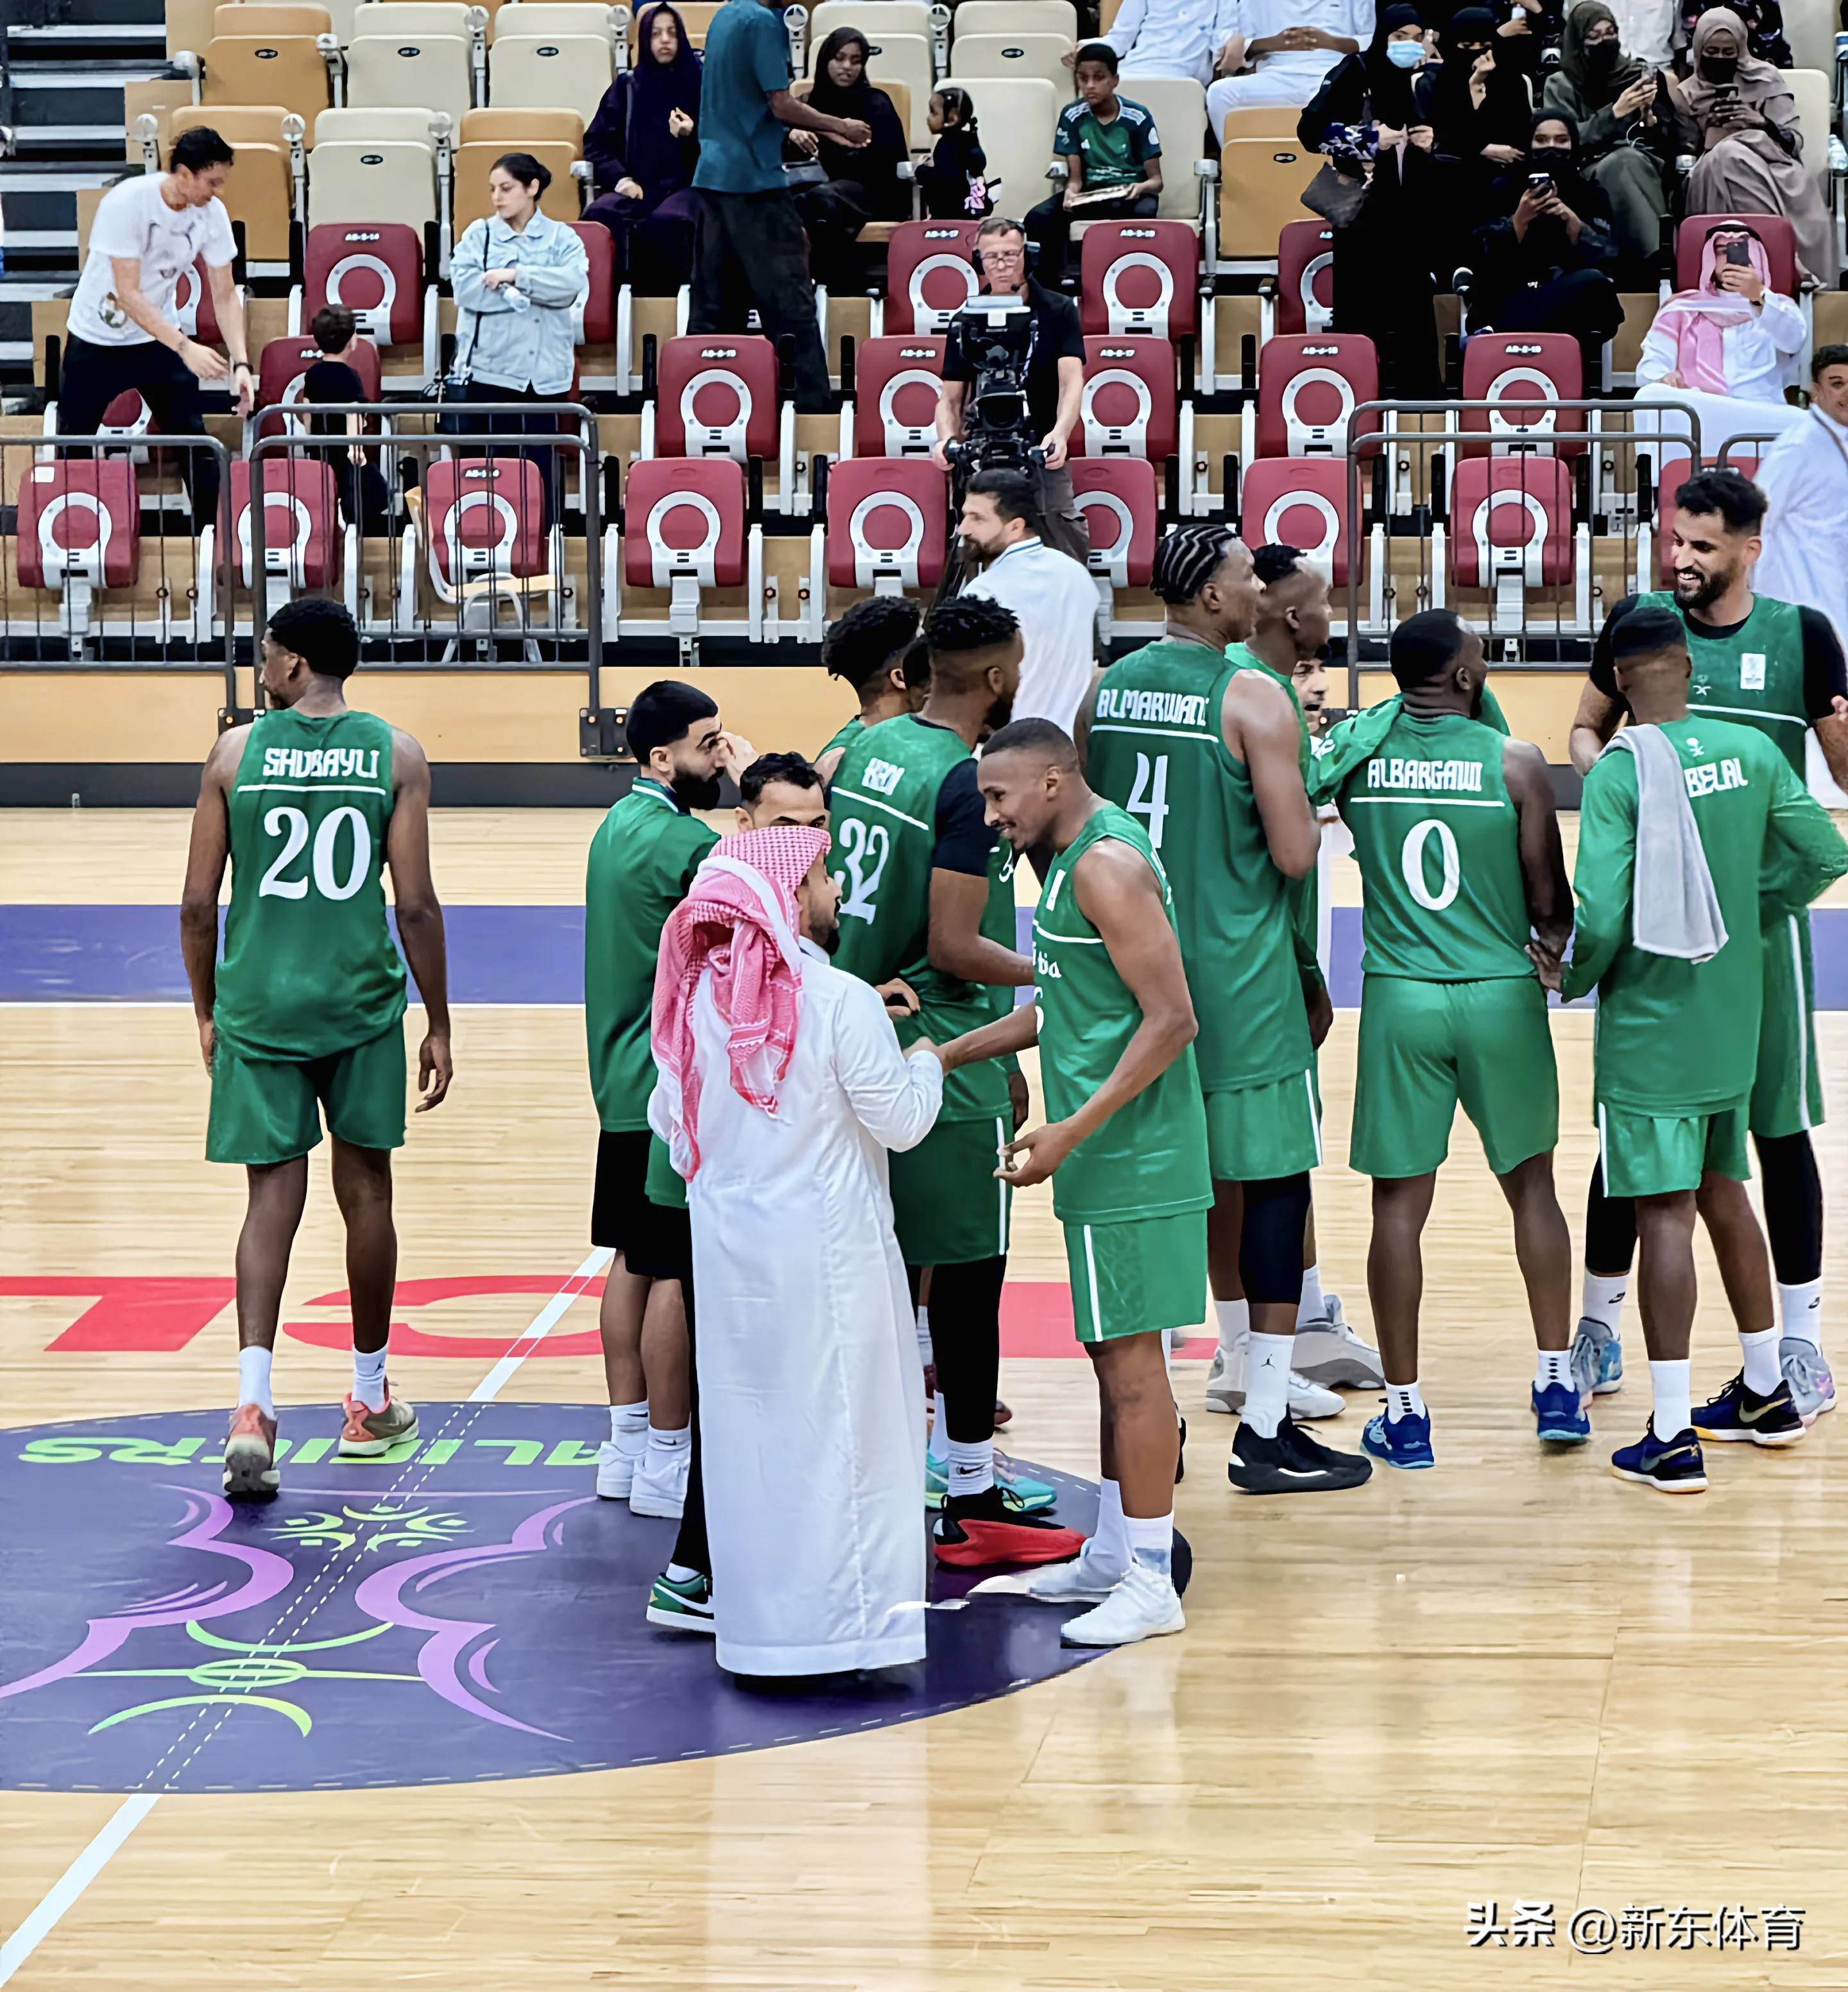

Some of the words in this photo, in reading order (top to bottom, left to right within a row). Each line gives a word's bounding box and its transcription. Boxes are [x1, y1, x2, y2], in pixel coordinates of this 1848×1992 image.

[262, 748, 380, 778] SHUBAYLI
[1126, 752, 1169, 848] 4
[1367, 759, 1484, 791] ALBARGAWI
[259, 806, 371, 900] 20
[834, 818, 889, 925] 32
[1401, 819, 1460, 911] 0
